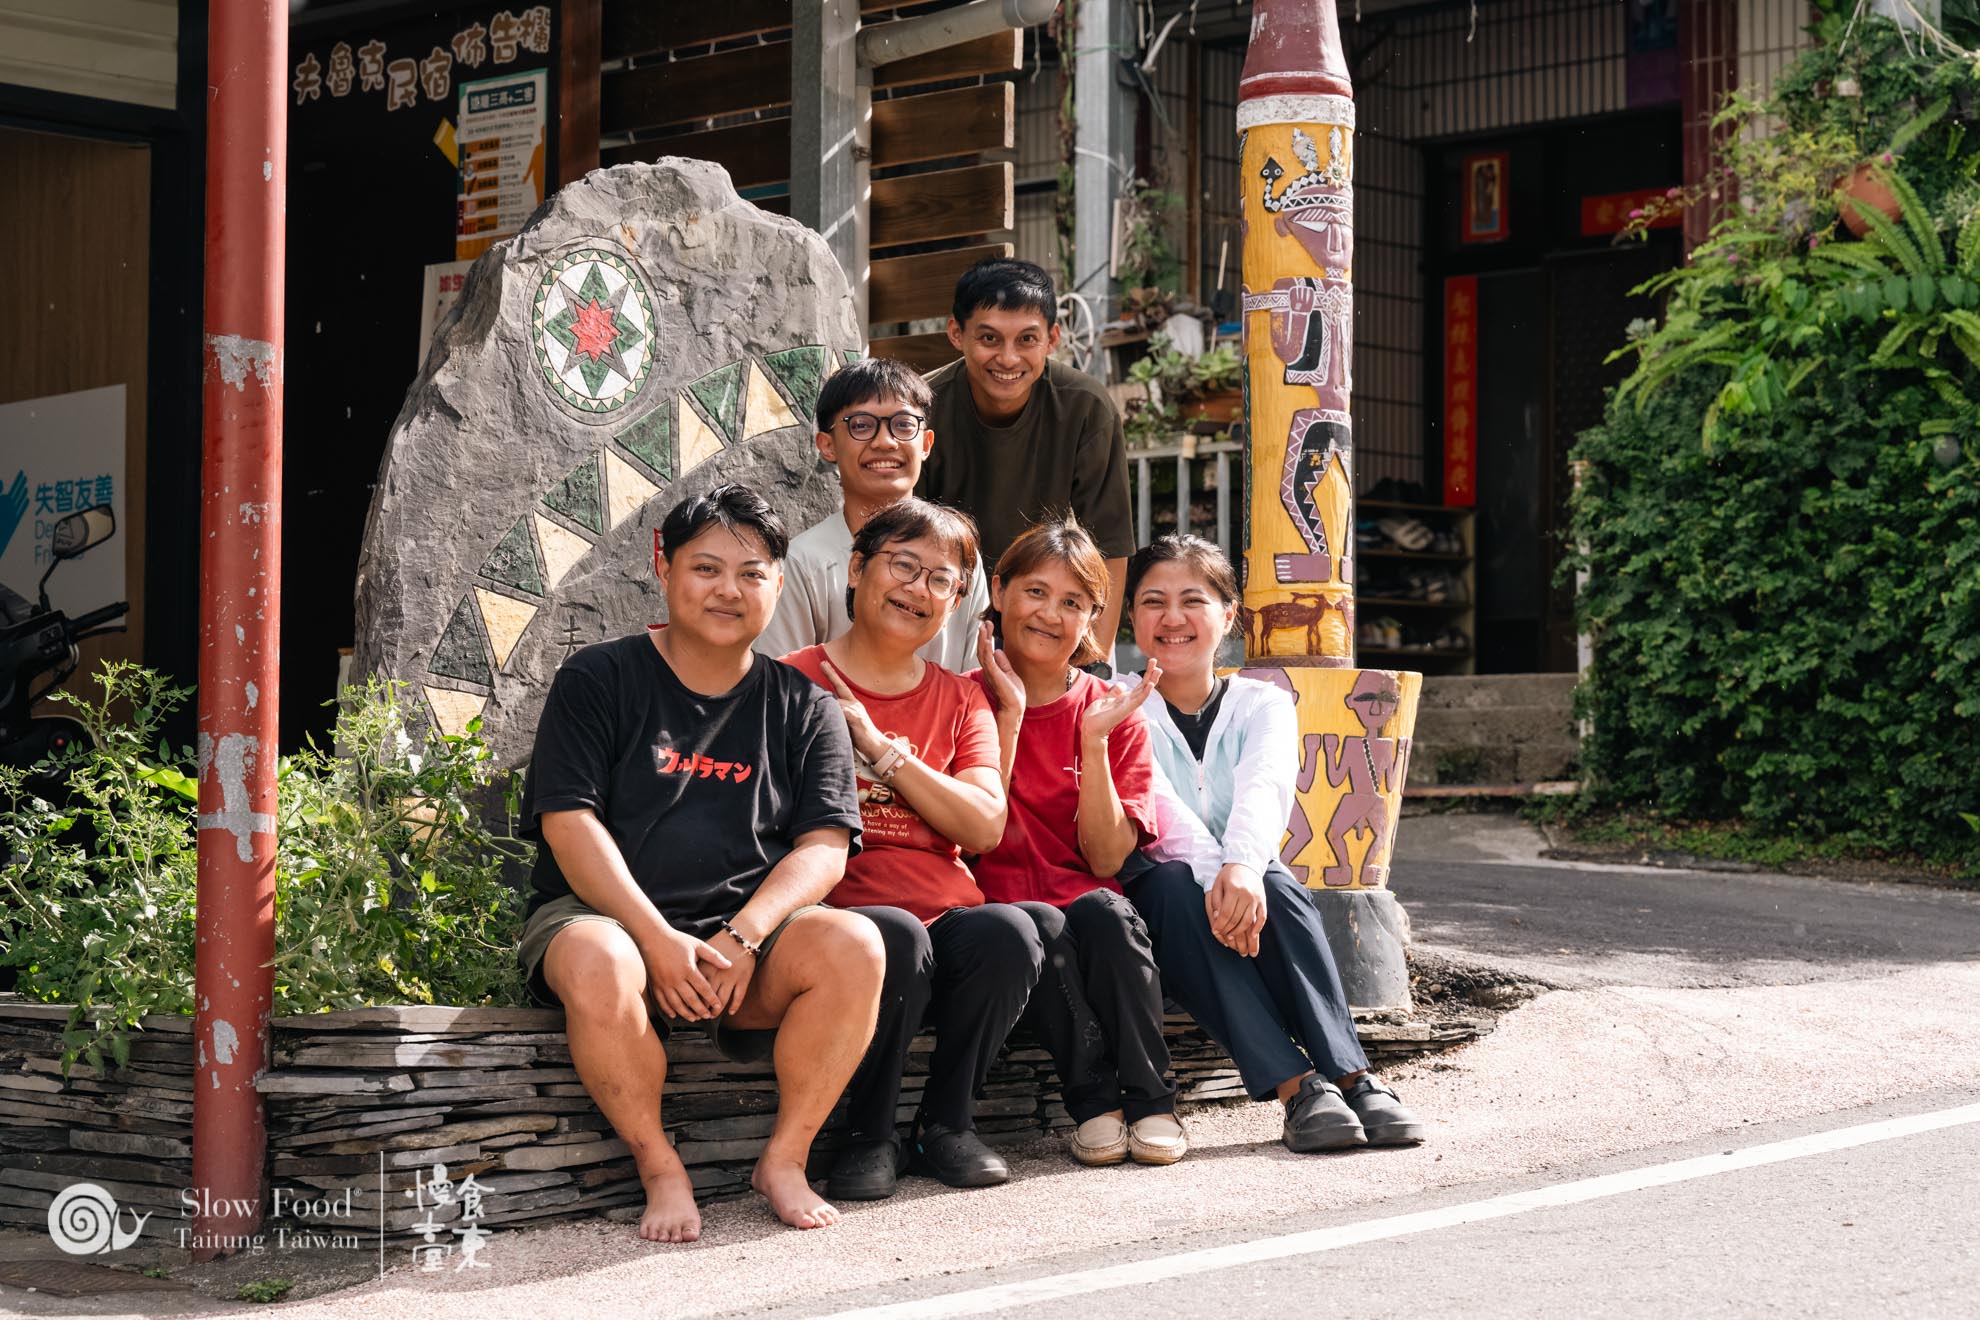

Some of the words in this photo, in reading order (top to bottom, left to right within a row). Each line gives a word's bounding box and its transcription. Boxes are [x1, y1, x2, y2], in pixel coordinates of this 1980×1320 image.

[35, 473, 114, 516] 失智友善
[656, 746, 752, 784] ウルトラマン
[867, 819, 882, 827] have
